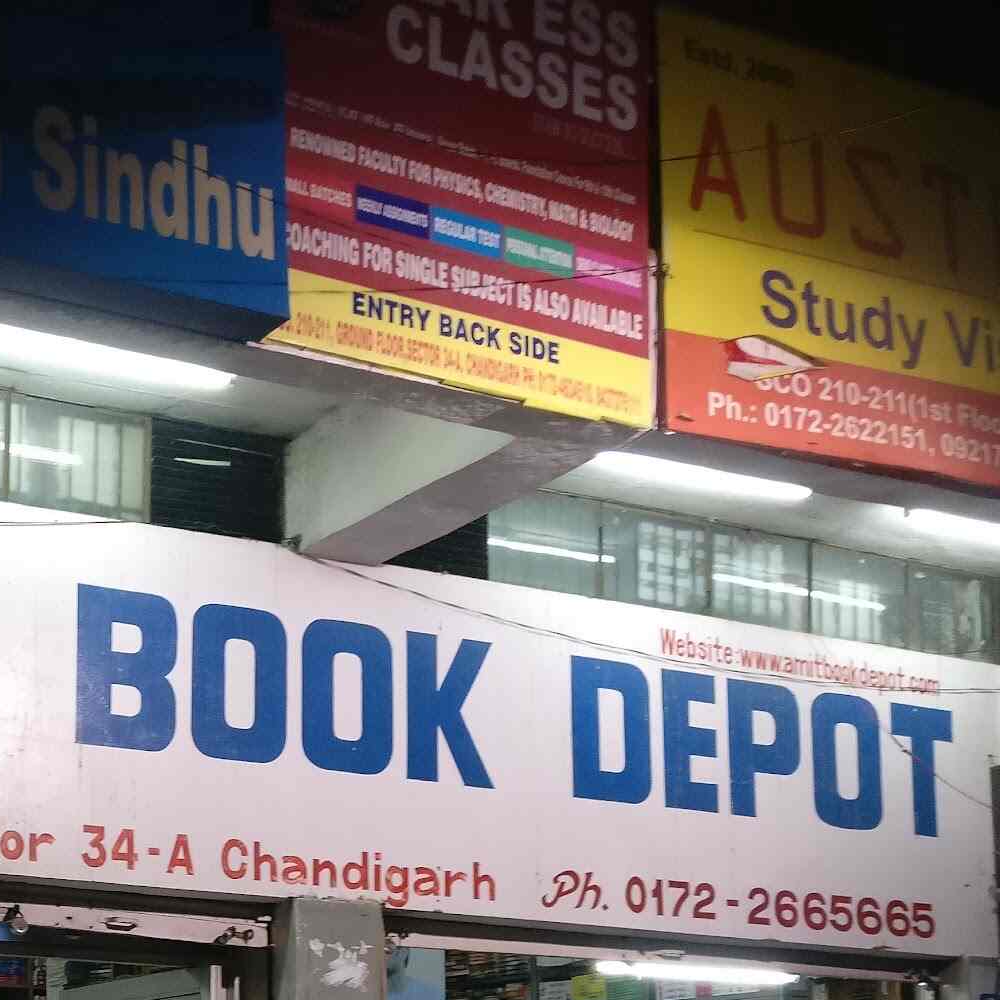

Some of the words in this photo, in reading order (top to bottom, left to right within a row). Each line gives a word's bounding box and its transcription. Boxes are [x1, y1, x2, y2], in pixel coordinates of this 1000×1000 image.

[386, 5, 638, 131] CLASSES
[32, 105, 275, 260] Sindhu
[290, 126, 356, 163] RENOWNED
[357, 145, 407, 177] FACULTY
[408, 160, 432, 185] FOR
[353, 291, 431, 331] ENTRY
[440, 313, 501, 350] BACK
[509, 331, 560, 364] SIDE
[362, 241, 393, 274] FOR
[395, 250, 449, 289] SINGLE
[451, 265, 514, 306] SUBJECT
[517, 281, 532, 311] IS
[533, 287, 570, 321] ALSO
[572, 297, 643, 340] AVAILABLE
[761, 269, 926, 370] Study
[944, 312, 1000, 373] Vi
[764, 402, 935, 456] 0172-2622151,
[76, 583, 495, 789] BOOK
[571, 655, 953, 838] DEPOT
[82, 824, 194, 876] 34-A
[221, 838, 496, 907] Chandigarh
[542, 869, 609, 911] Ph.
